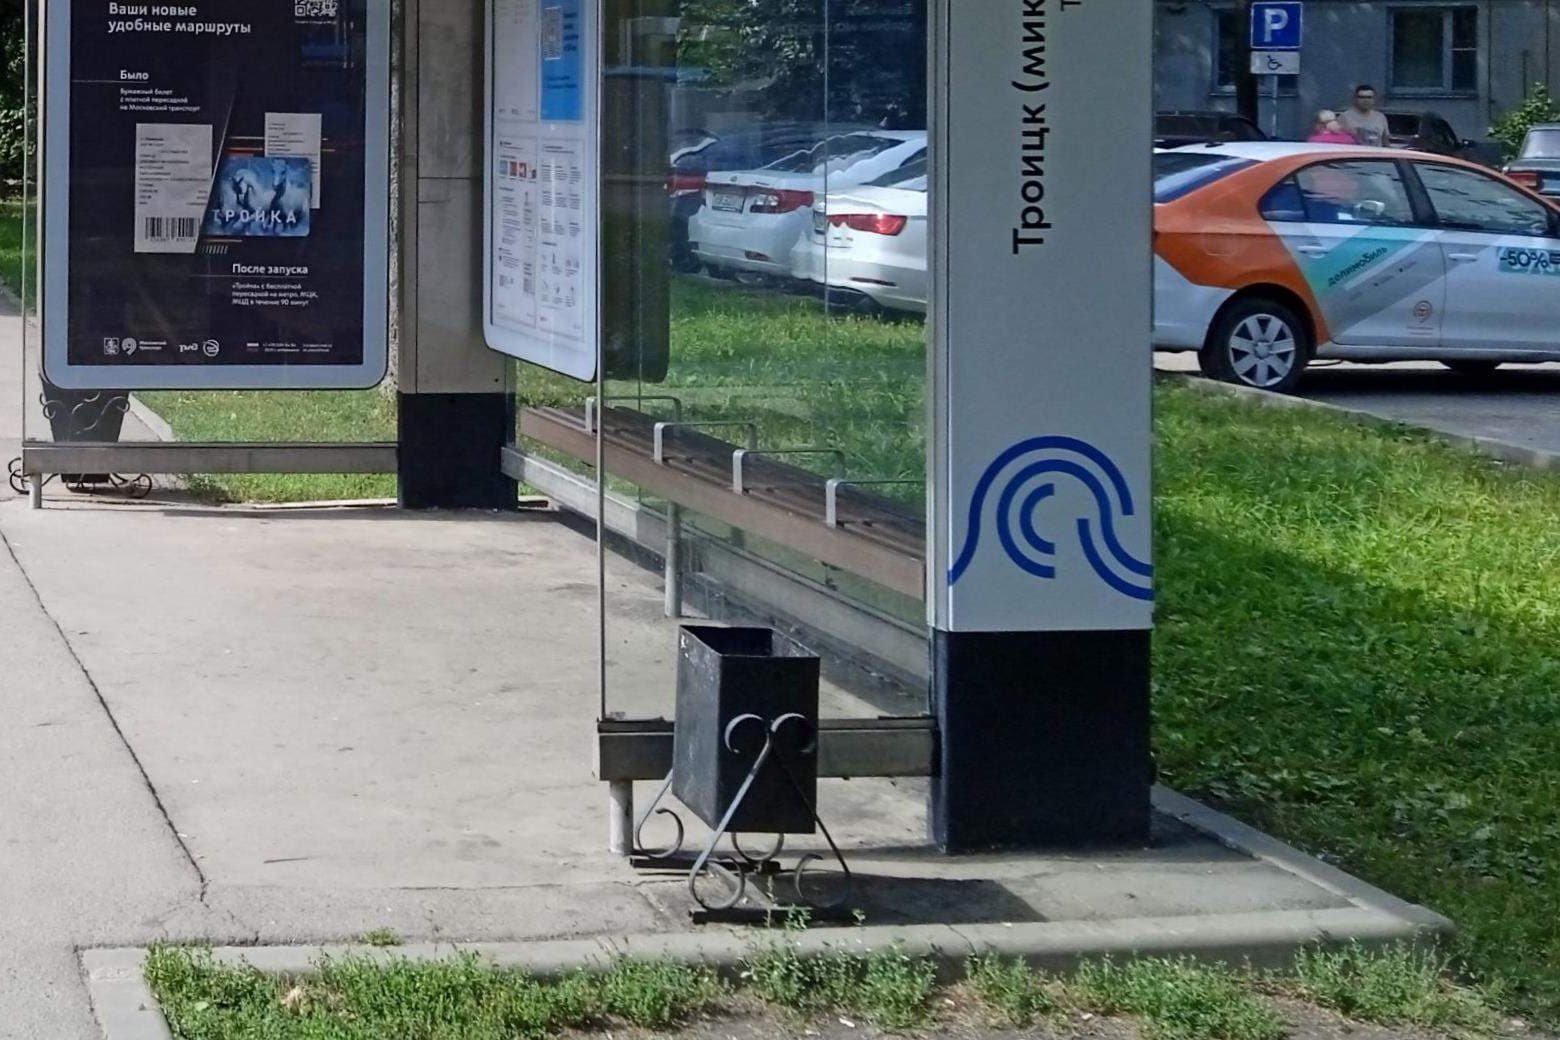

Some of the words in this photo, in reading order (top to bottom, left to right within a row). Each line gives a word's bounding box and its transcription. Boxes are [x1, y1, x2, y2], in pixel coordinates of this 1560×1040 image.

[109, 2, 148, 16] Ваши
[151, 6, 198, 17] новые
[108, 18, 172, 33] удобные
[175, 23, 251, 37] маршруты
[1263, 8, 1289, 43] P
[120, 69, 150, 80] Было
[1012, 104, 1052, 255] Троицк
[232, 263, 266, 274] После
[268, 266, 309, 277] запуска
